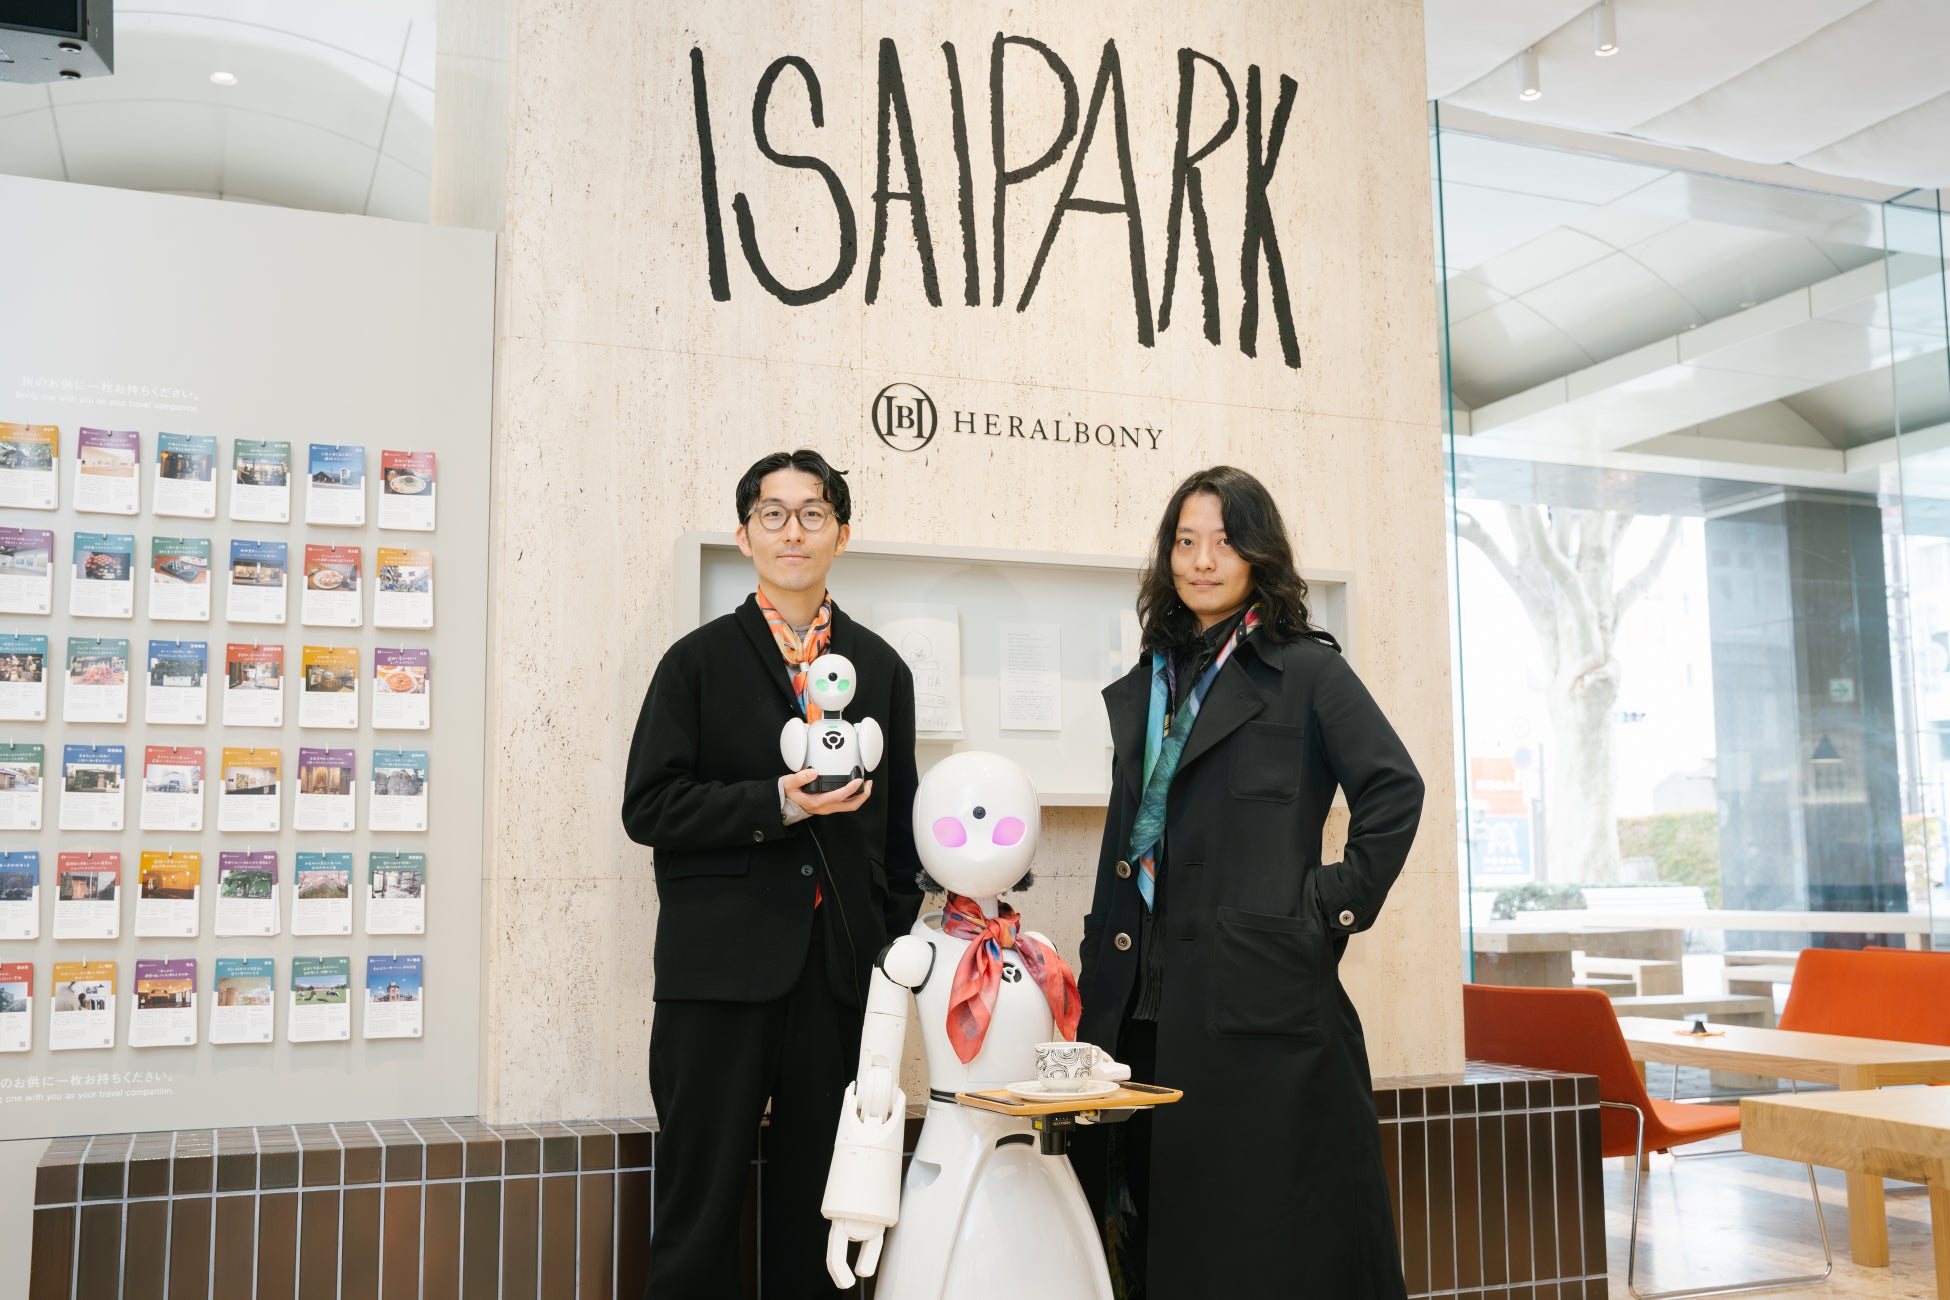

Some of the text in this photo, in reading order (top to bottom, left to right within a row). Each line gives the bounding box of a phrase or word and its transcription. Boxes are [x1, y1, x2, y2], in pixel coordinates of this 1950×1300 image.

[690, 31, 1300, 369] ISAIPARK
[953, 410, 1164, 449] HERALBONY
[25, 1093, 43, 1101] with
[46, 1094, 62, 1102] you
[78, 1091, 96, 1100] your
[99, 1089, 123, 1098] travel
